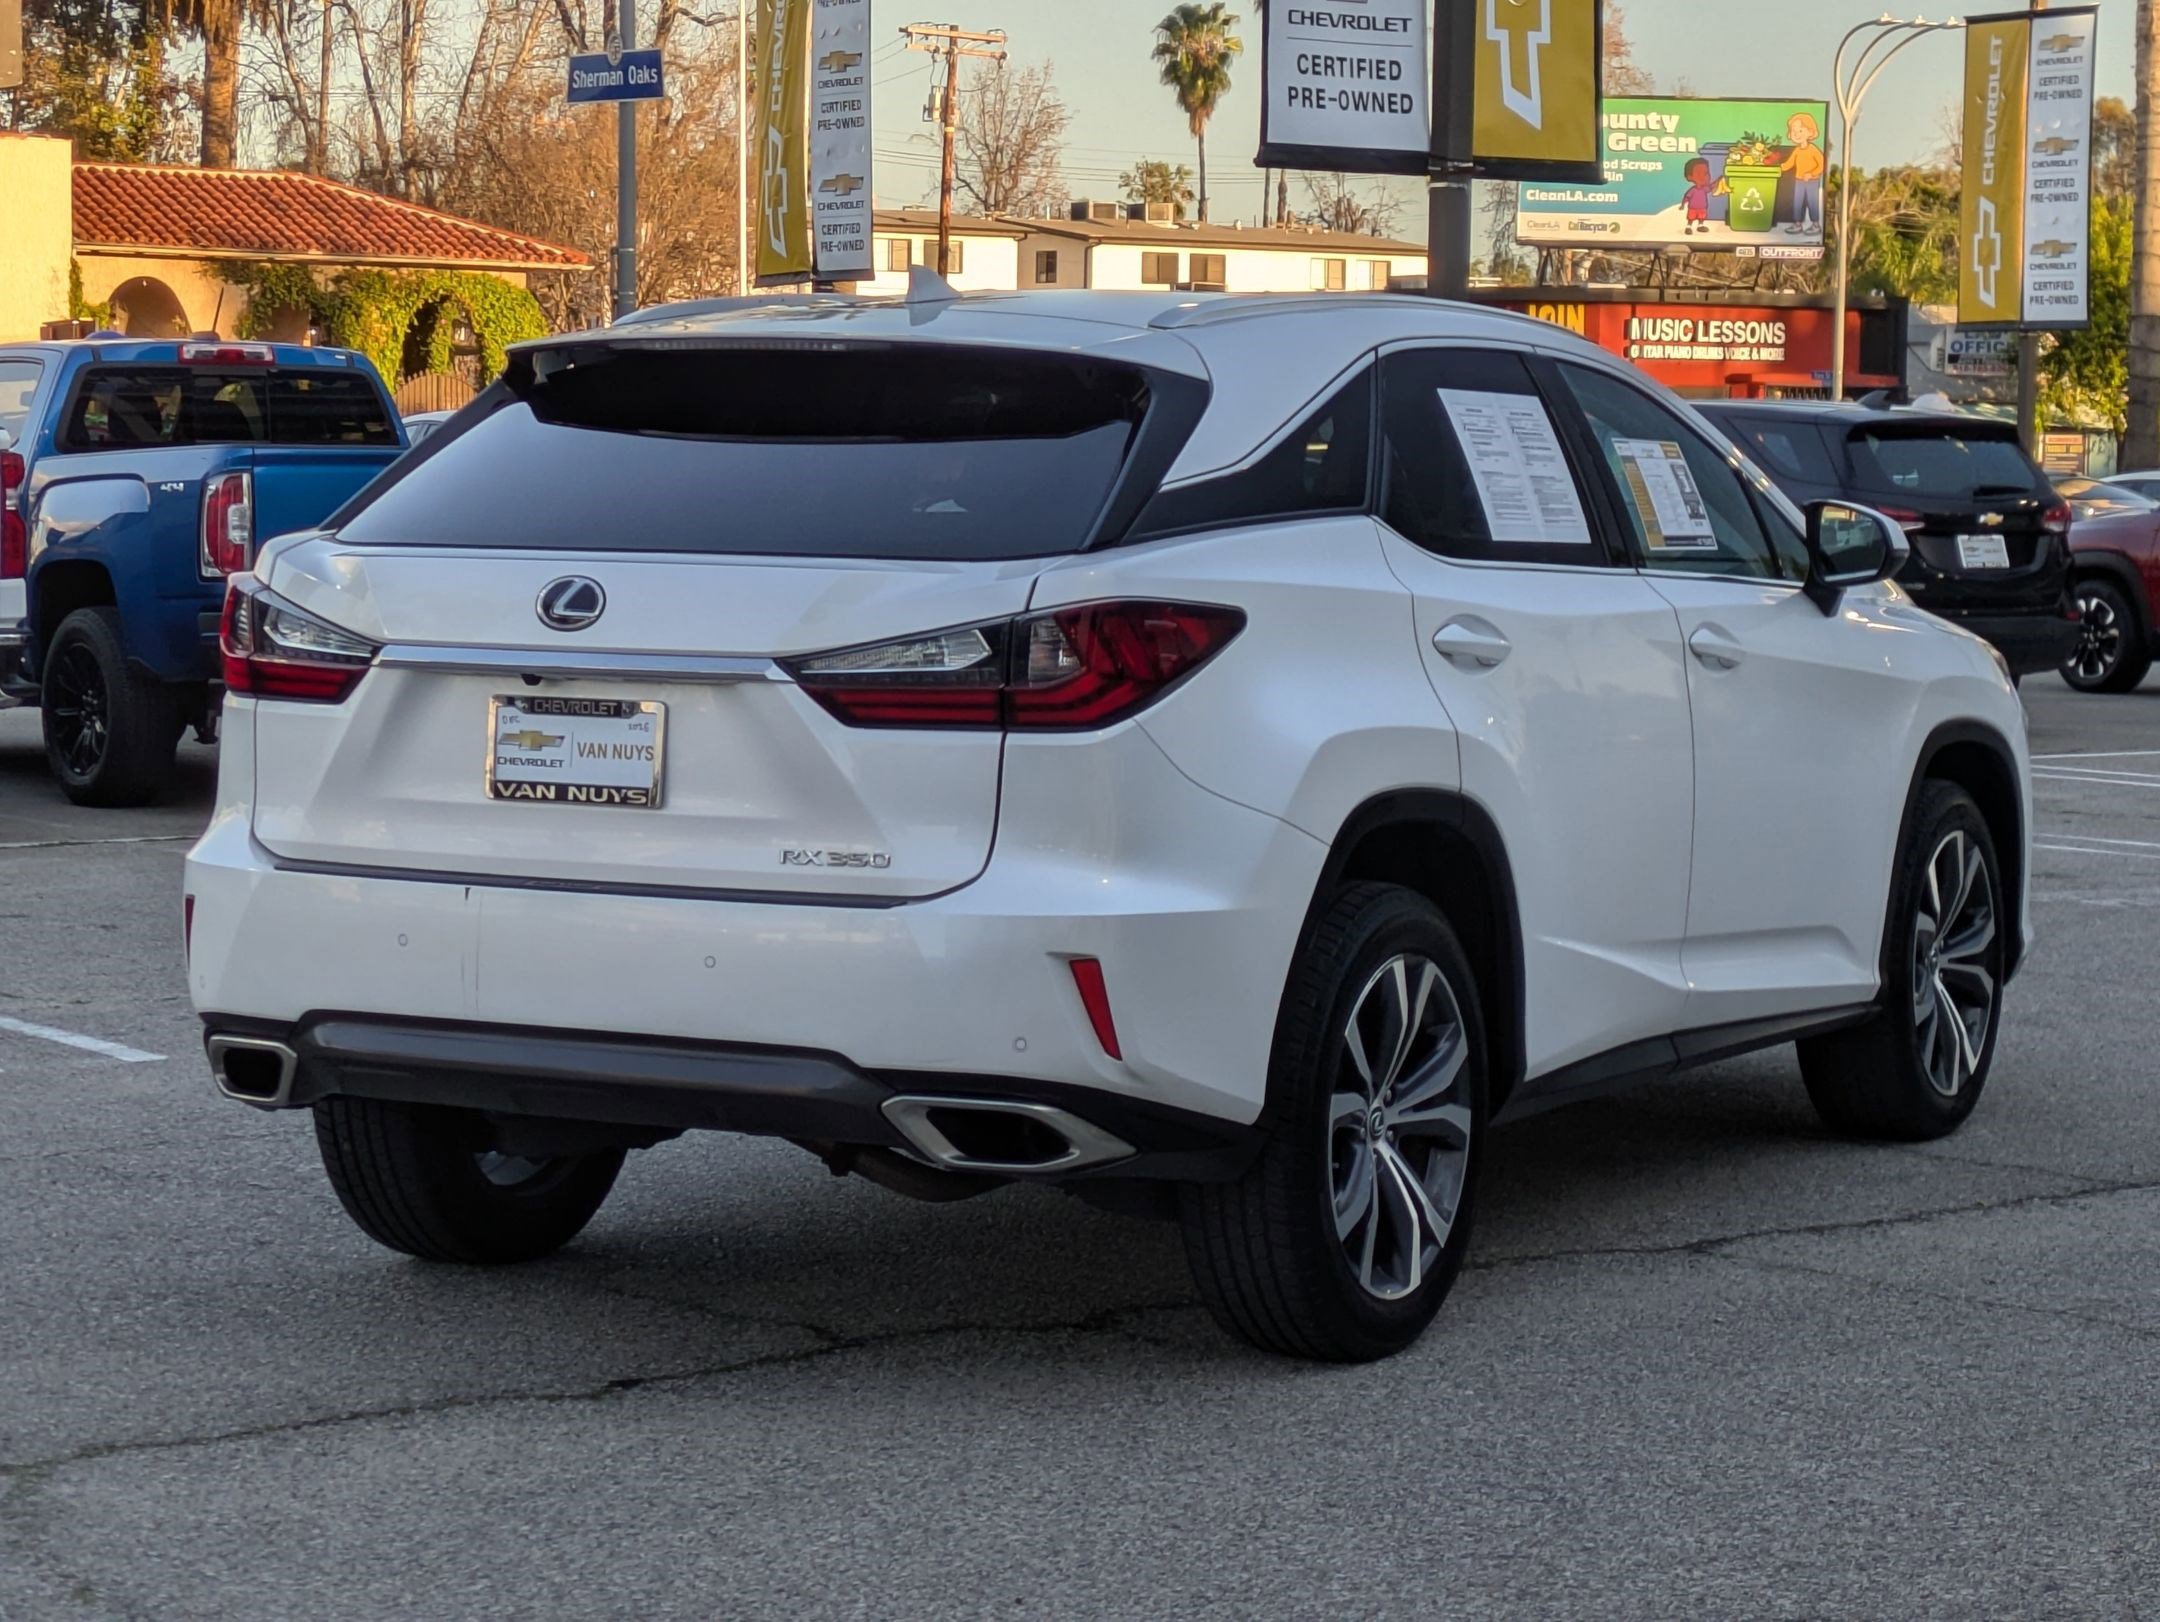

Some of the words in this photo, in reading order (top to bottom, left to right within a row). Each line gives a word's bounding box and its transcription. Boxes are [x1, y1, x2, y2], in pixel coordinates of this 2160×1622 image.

[1288, 9, 1413, 33] CHEVROLET
[1297, 53, 1402, 81] CERTIFIED
[572, 69, 624, 89] Sherman
[628, 65, 658, 85] Oaks
[818, 76, 864, 89] CHEVROLET
[2039, 75, 2080, 86] CERTIFIED
[821, 99, 862, 113] CERTIFIED
[1287, 86, 1414, 114] PRE-OWNED
[1982, 34, 2003, 185] CHEVROLET
[818, 116, 865, 131] PRE-OWNED
[1608, 132, 1697, 152] Green
[1621, 160, 1663, 171] Scraps
[2033, 178, 2075, 188] CERTIFIED
[1526, 189, 1619, 203] CleanLA.com
[817, 200, 865, 211] CHEVROLET
[821, 223, 861, 235] CERTIFIED
[820, 240, 865, 252] PRE-OWNED
[2033, 281, 2074, 291] CERTIFIED
[1630, 317, 1694, 342] MUSIC
[1697, 320, 1786, 344] LESSONS
[534, 699, 618, 715] CHEVROLET
[576, 742, 608, 760] VAN
[613, 744, 655, 762] NUYS
[497, 756, 566, 768] CHEVROLET
[497, 782, 556, 800] VAN
[567, 786, 647, 803] NUYS
[780, 849, 825, 866] RX
[827, 852, 892, 869] 350
